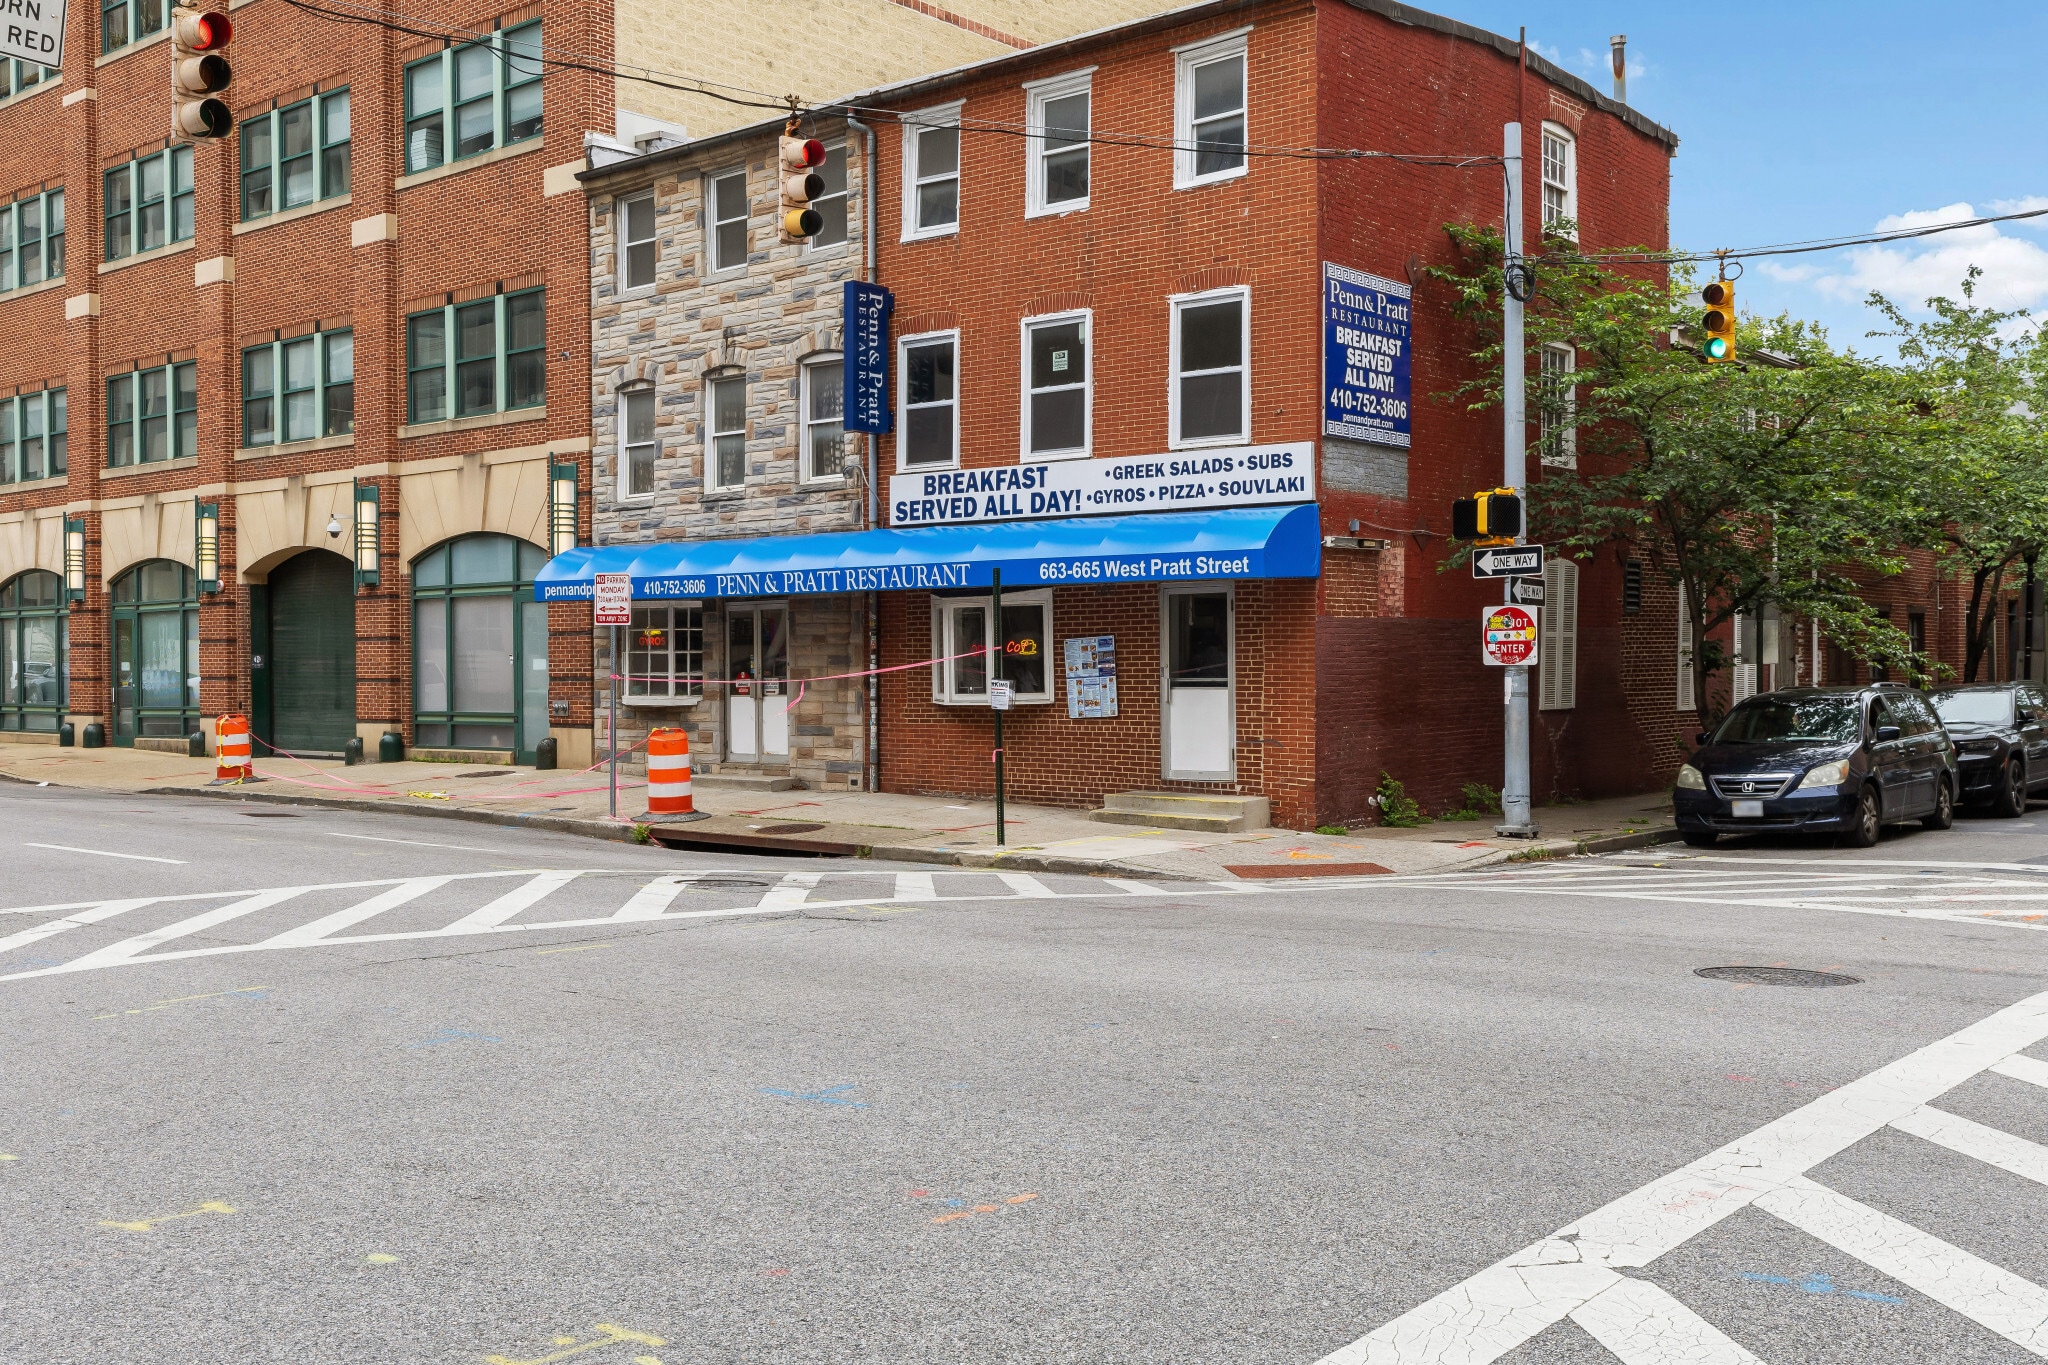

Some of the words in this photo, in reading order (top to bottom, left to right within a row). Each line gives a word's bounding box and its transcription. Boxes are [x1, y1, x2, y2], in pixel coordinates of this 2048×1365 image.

[8, 25, 55, 53] RED
[869, 292, 884, 347] Penn
[1377, 293, 1409, 322] Pratt
[1331, 307, 1407, 337] RESTAURANT
[1336, 326, 1402, 357] BREAKFAST
[858, 293, 867, 421] RESTAURANT
[869, 350, 880, 367] &
[1346, 347, 1393, 373] SERVED
[1344, 367, 1367, 387] ALL
[1368, 372, 1395, 393] DAY!
[868, 371, 883, 427] Pratt
[1330, 388, 1407, 419] 410-752-3606
[1342, 413, 1394, 429] pennandpratt.com
[1113, 462, 1166, 480] GREEK
[1169, 457, 1234, 477] SALADS
[1246, 452, 1293, 471] SUBS
[923, 466, 1048, 496] BREAKFAST
[1093, 487, 1146, 504] GYROS
[1158, 483, 1206, 501] PIZZA
[1218, 476, 1305, 497] SOUVLAKI
[895, 496, 978, 522] SERVED
[983, 494, 1024, 517] ALL
[1030, 489, 1082, 514] DAY!
[1039, 561, 1101, 580] 663-665
[1104, 560, 1146, 577] West
[1150, 558, 1192, 576] Pratt
[1196, 556, 1250, 574] Street
[1493, 556, 1511, 568] ONE
[1514, 554, 1534, 566] WAY
[597, 576, 605, 584] NO
[606, 576, 627, 584] PARKING
[600, 586, 625, 594] MONDAY
[643, 579, 706, 595] 410-752-3606
[716, 574, 760, 595] PENN
[764, 574, 779, 593] &
[783, 570, 841, 593] PRATT
[845, 563, 971, 590] RESTAURANT
[1520, 584, 1531, 597] ONE
[1532, 585, 1543, 597] WAY
[639, 636, 665, 646] GYROS
[1495, 644, 1525, 654] ENTER
